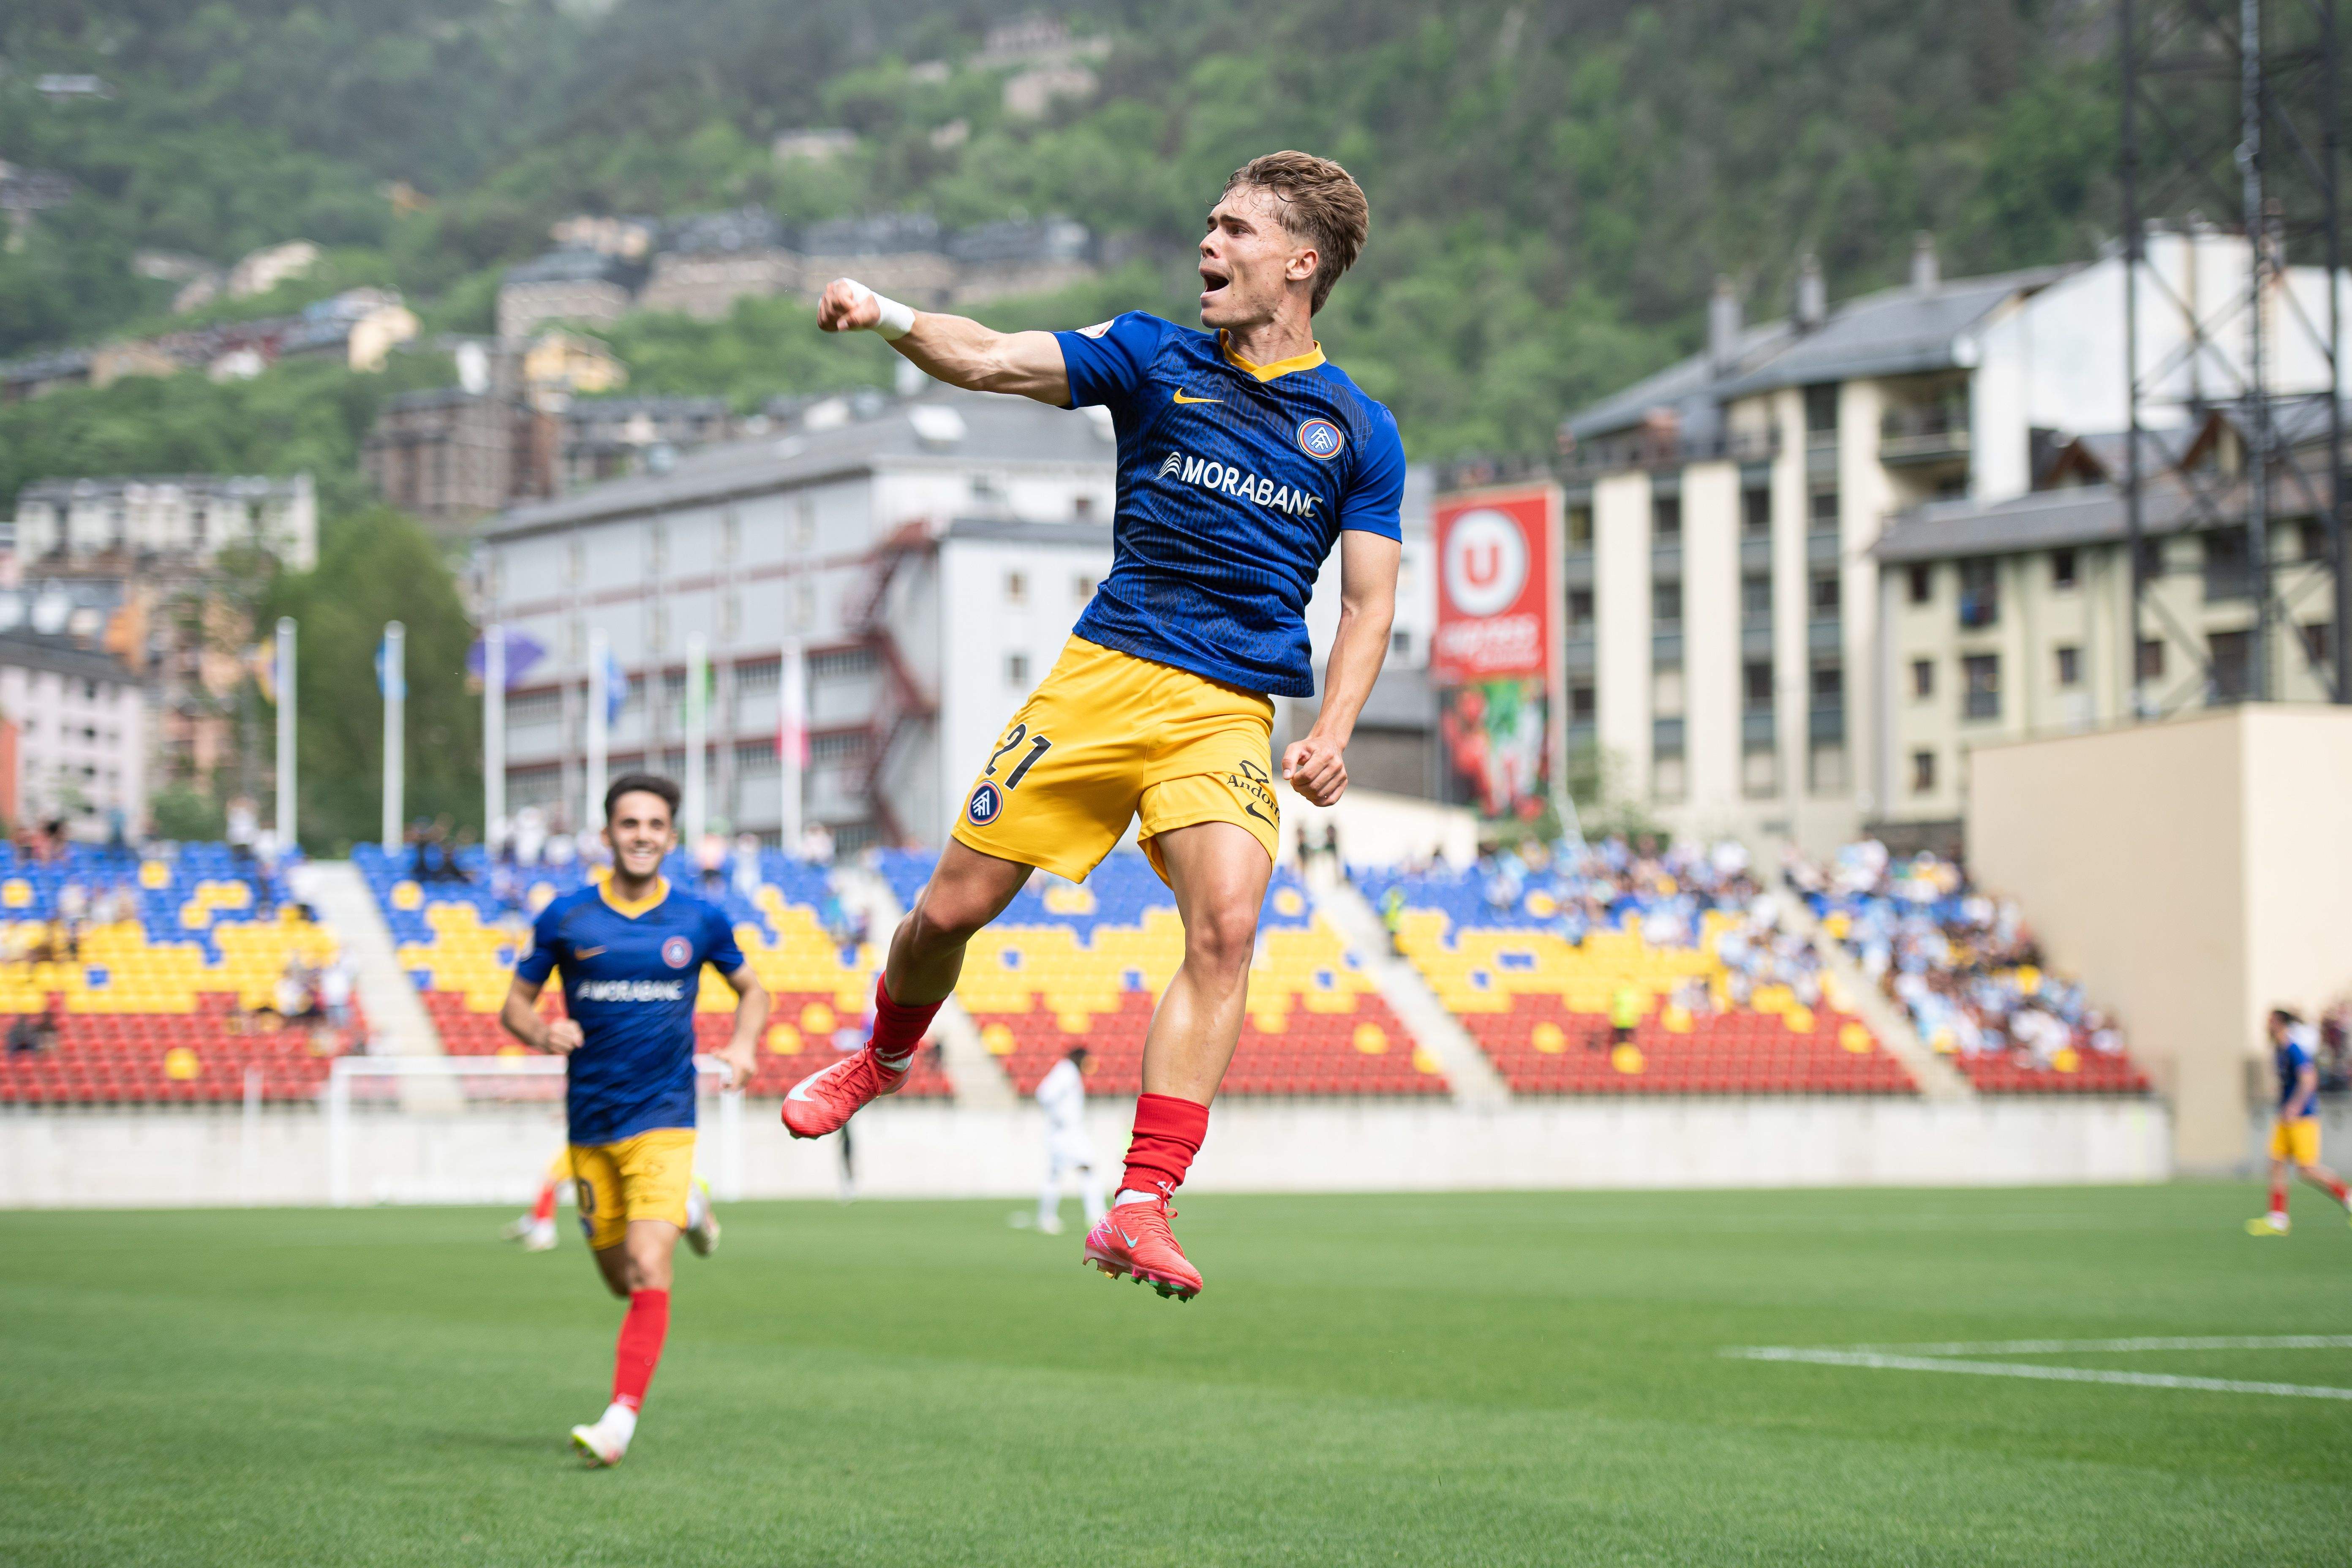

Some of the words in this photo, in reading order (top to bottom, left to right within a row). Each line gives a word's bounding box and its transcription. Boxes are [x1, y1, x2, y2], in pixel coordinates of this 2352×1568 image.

[1181, 456, 1323, 517] MORABANC
[1464, 542, 1502, 588] U
[984, 723, 1053, 790] 21
